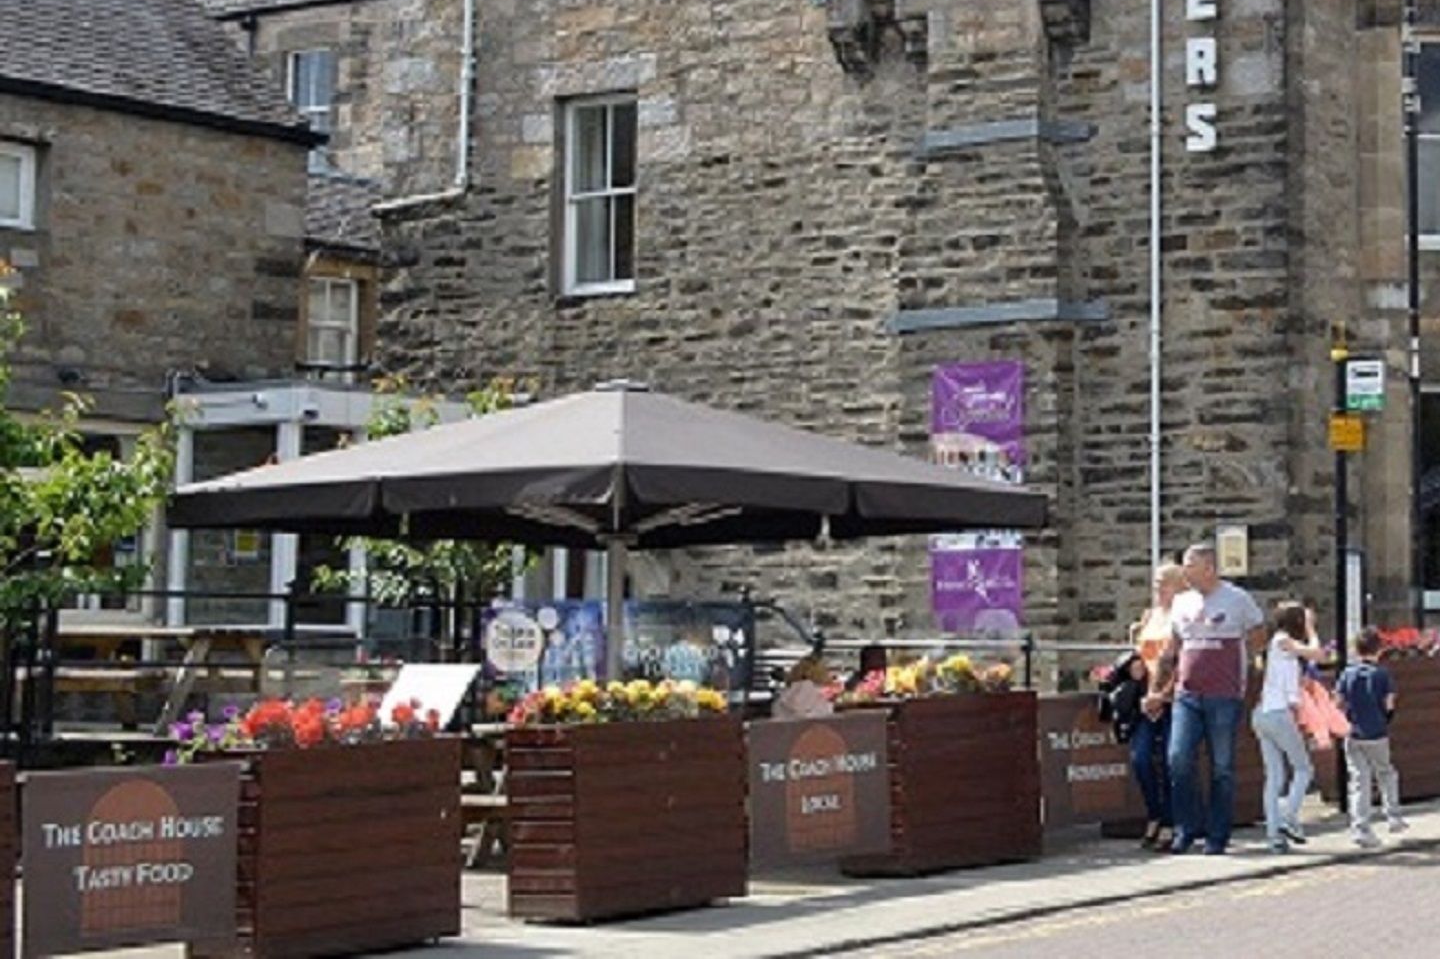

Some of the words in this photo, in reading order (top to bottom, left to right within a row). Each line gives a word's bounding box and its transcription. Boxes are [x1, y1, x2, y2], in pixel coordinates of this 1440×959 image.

[759, 762, 786, 783] THE
[41, 823, 81, 848] THE
[87, 820, 154, 845] COACH
[160, 815, 225, 839] HOUSE
[72, 865, 133, 891] TASTY
[135, 861, 194, 885] FOOD
